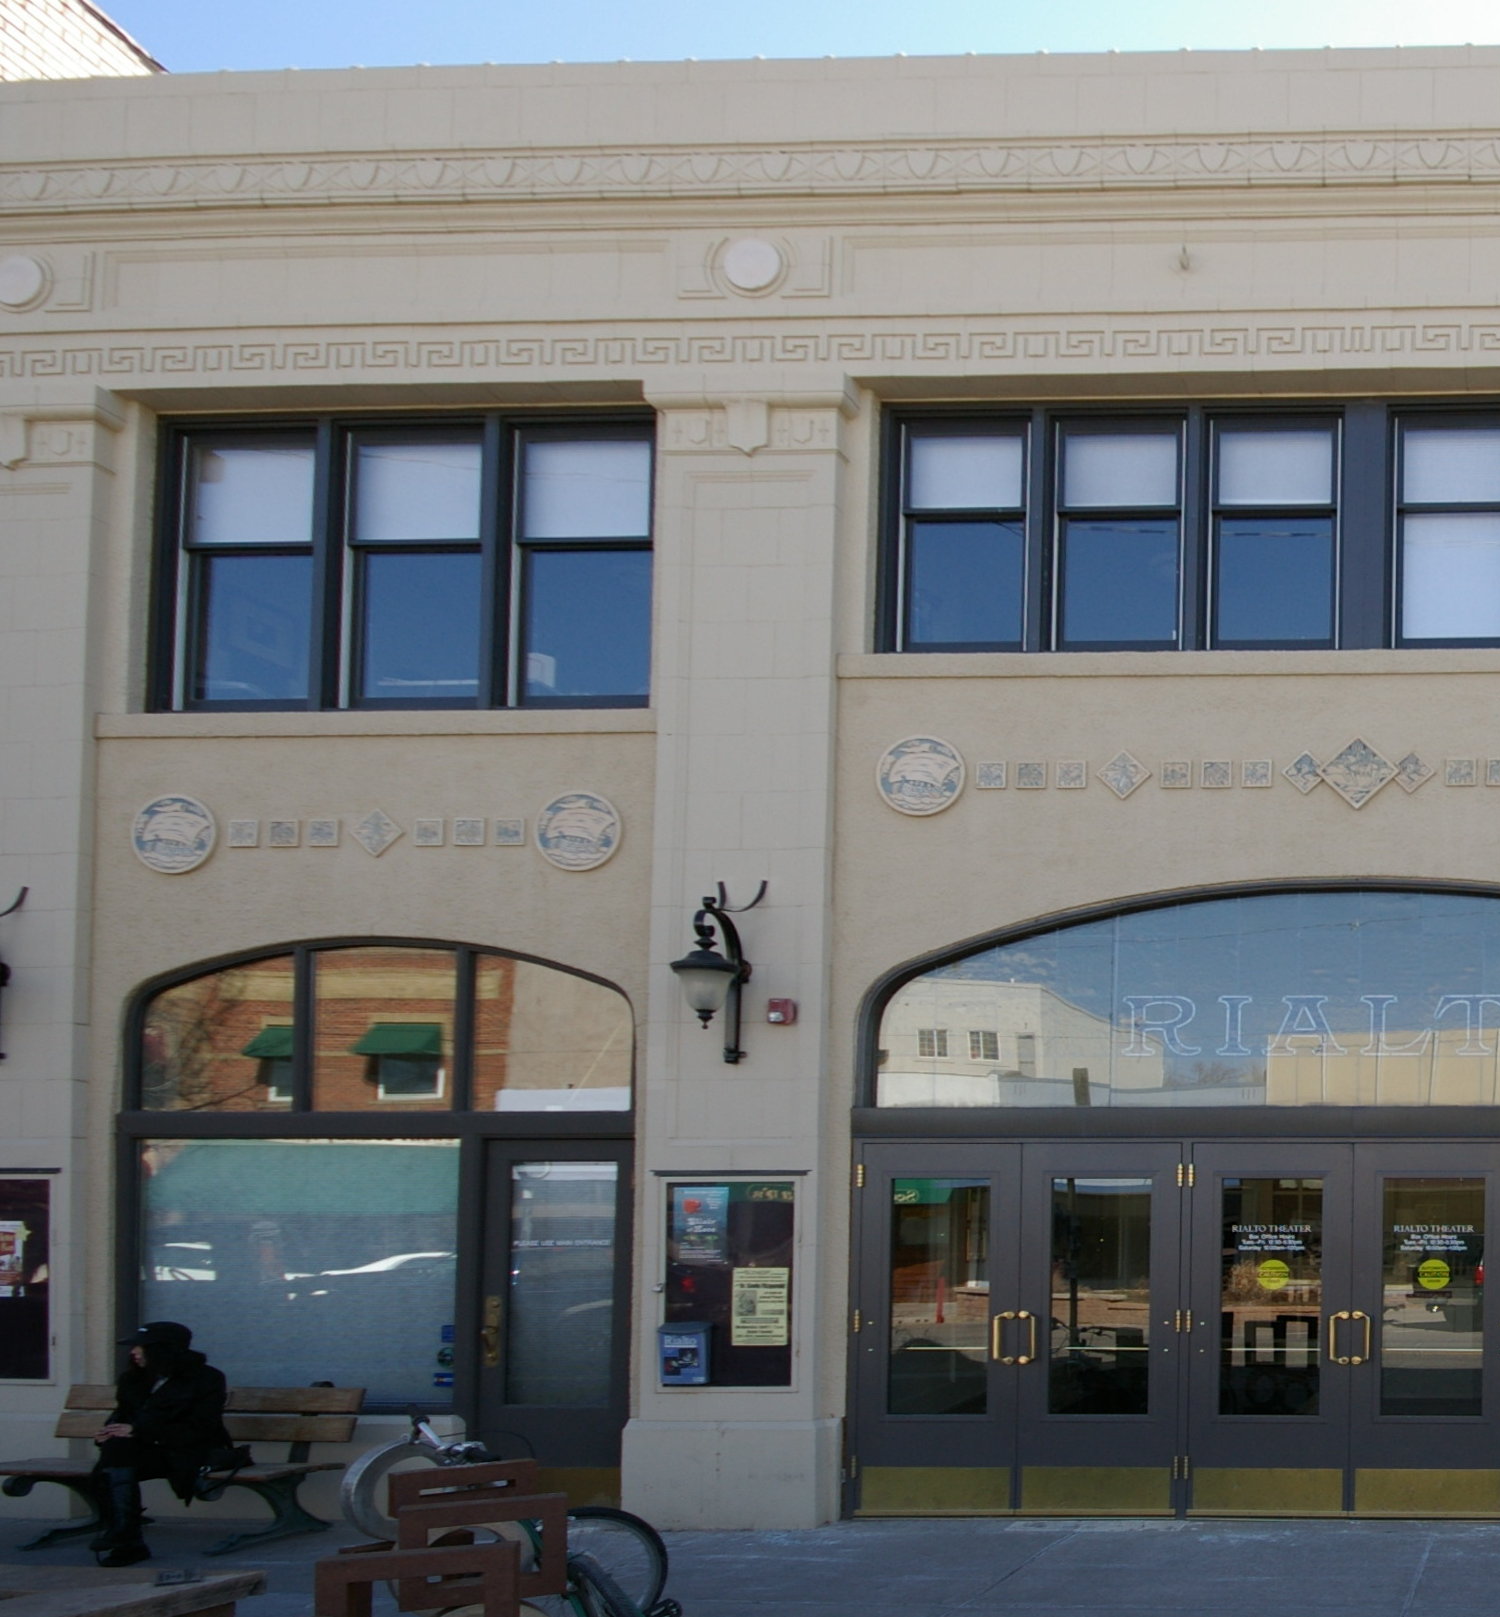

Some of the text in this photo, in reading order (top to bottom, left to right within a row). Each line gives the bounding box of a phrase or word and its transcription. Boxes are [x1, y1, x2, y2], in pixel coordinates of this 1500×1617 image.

[1231, 1224, 1312, 1232] RIALTO THEATER
[1393, 1224, 1474, 1232] RIALTO THEATER
